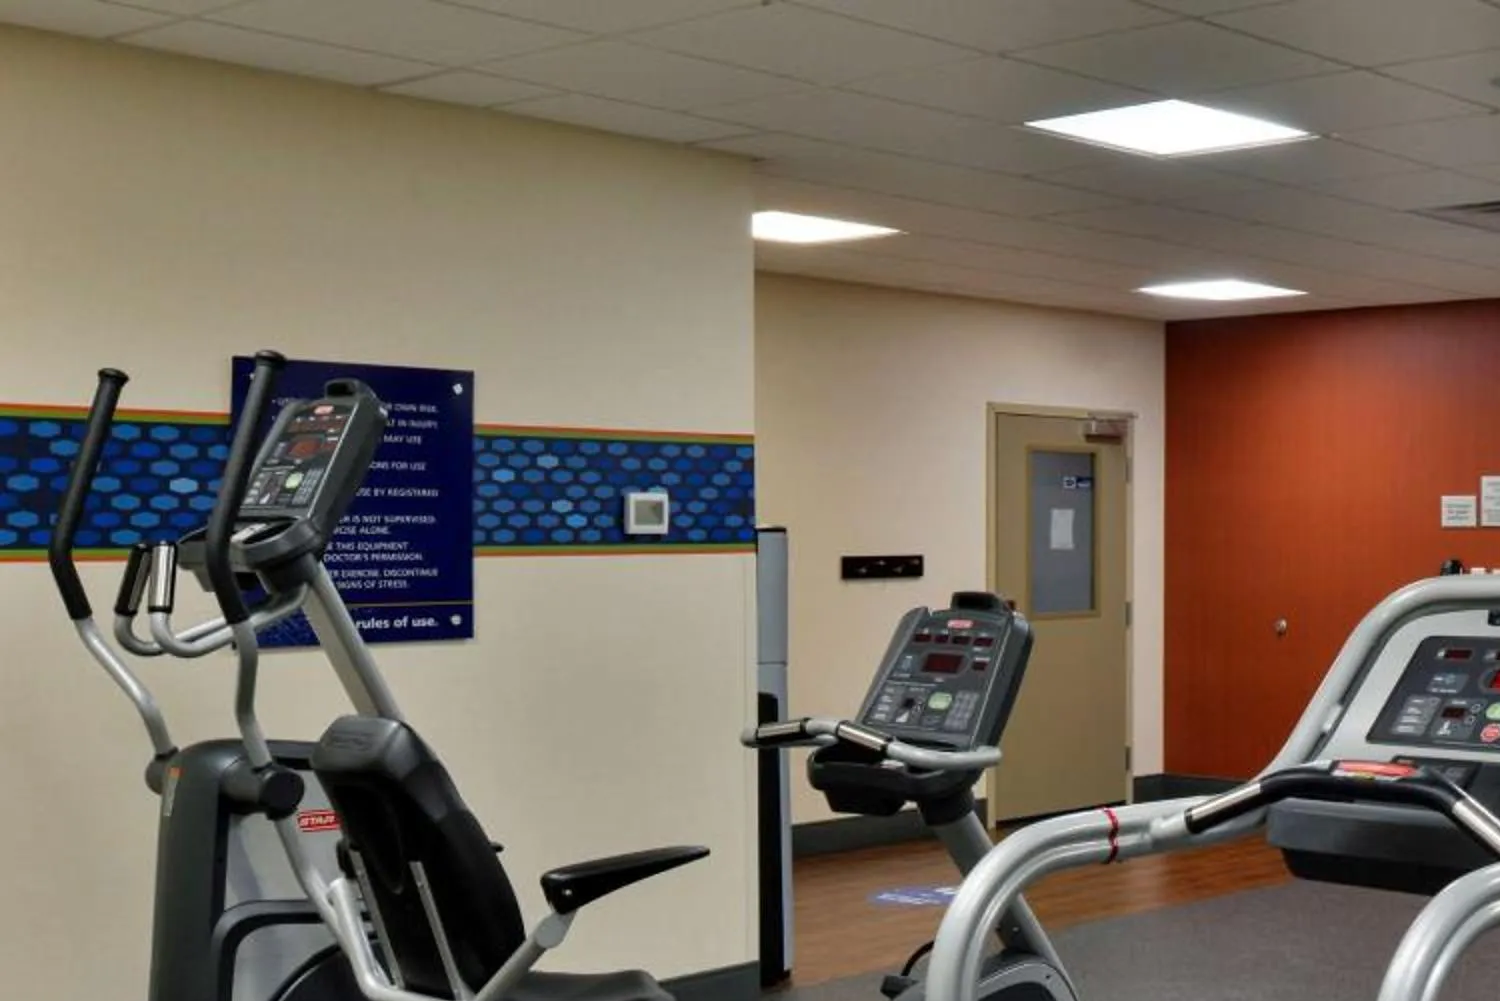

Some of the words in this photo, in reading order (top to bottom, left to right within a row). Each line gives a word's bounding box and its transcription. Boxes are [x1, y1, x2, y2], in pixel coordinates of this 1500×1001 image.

[391, 461, 409, 471] FOR
[373, 487, 385, 497] BY
[362, 514, 381, 523] NOT
[336, 541, 355, 550] THIS
[364, 580, 376, 589] OF
[356, 617, 390, 630] rules
[393, 616, 409, 627] of
[411, 617, 439, 628] use.
